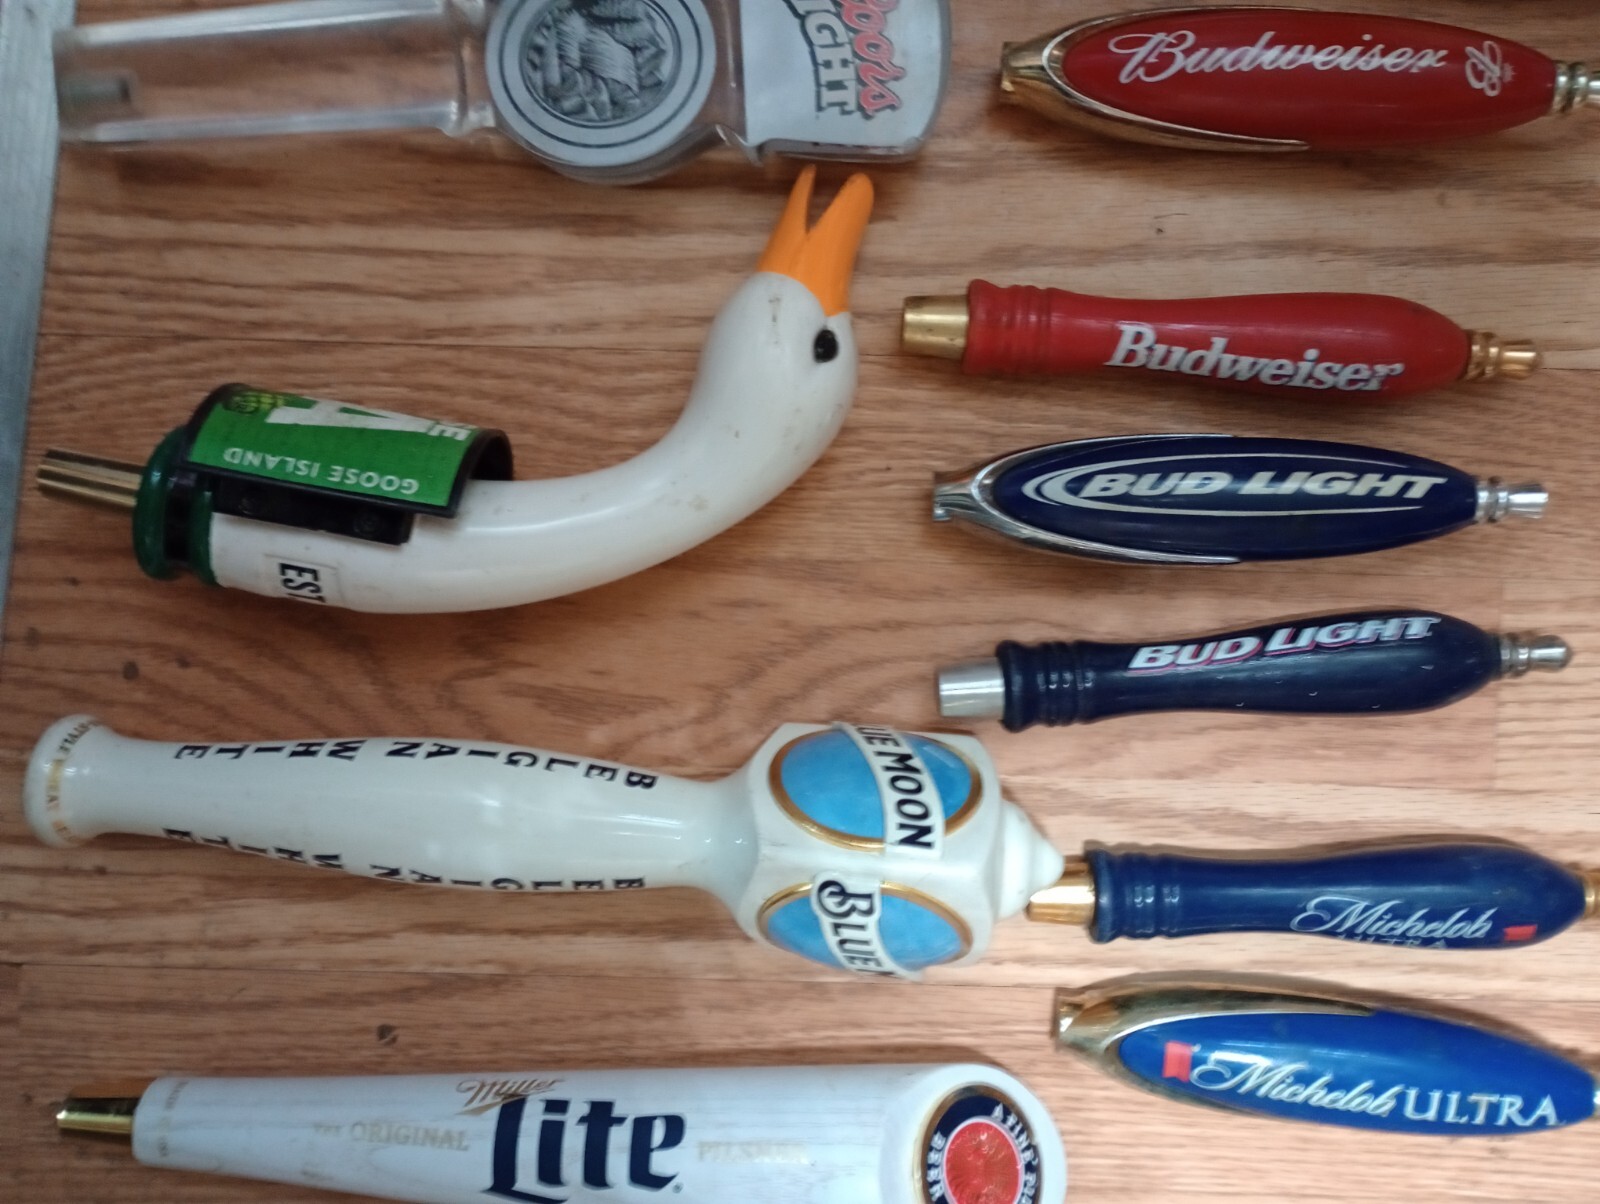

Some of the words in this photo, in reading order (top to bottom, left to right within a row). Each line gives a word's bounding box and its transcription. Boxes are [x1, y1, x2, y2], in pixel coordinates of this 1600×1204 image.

[788, 0, 858, 115] IGHT
[1107, 30, 1448, 84] Budweiser
[1104, 321, 1406, 392] Budweiser
[223, 447, 321, 478] ISLAND
[327, 464, 420, 495] GOOSE
[1077, 471, 1234, 499] BUD
[1237, 471, 1448, 499] LIGHT
[1125, 636, 1264, 676] BUD
[1263, 616, 1442, 656] LIGHT
[174, 738, 368, 761] WHITE
[385, 740, 658, 790] BELGIAN
[873, 751, 936, 849] MOON
[1290, 895, 1499, 939] Michelob
[456, 1079, 567, 1113] Miller
[1189, 1050, 1406, 1119] Michelob
[1402, 1085, 1561, 1127] ULTRA
[351, 1121, 471, 1152] ORIGINAL
[481, 1095, 687, 1204] Lite
[926, 1130, 948, 1202] BEER
